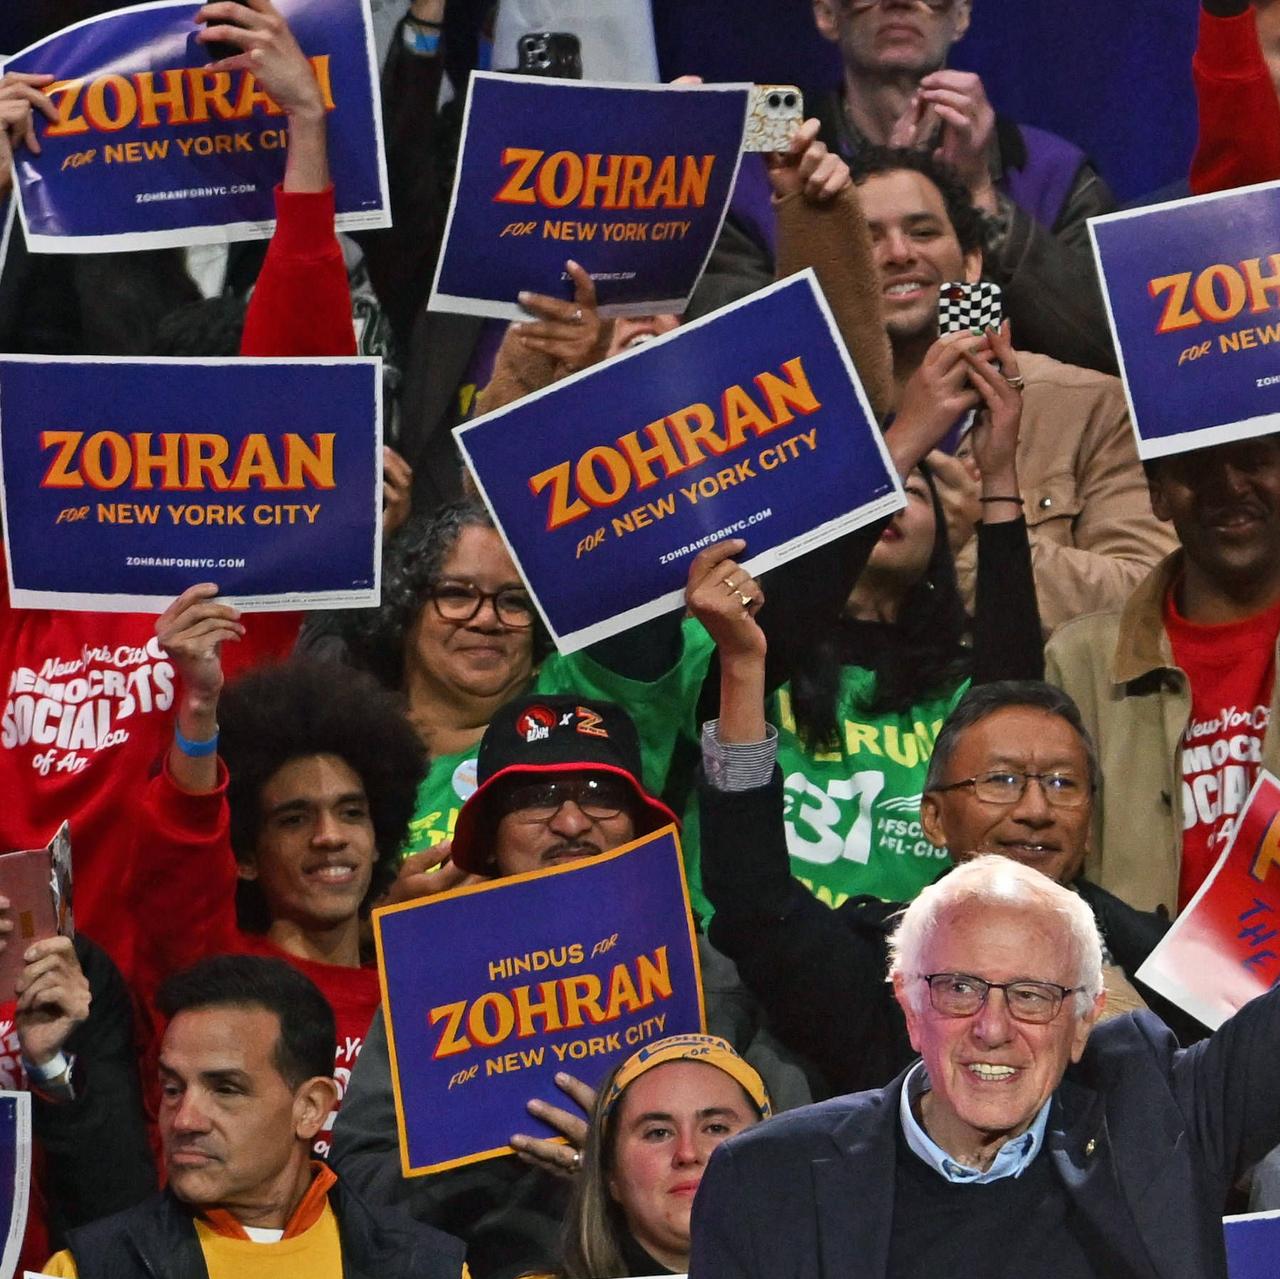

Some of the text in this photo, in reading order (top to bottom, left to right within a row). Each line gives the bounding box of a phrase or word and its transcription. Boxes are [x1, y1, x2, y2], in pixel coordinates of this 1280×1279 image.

[61, 130, 288, 171] FOR NEW YORK CI
[136, 185, 256, 203] ZOHRANFORNYC.COM
[493, 147, 716, 210] ZOHRAN
[500, 220, 691, 242] FOR NEW YORK CITY
[1177, 340, 1212, 366] FOR
[39, 430, 338, 491] ZOHRAN
[528, 356, 822, 531] ZOHRAN
[56, 504, 321, 525] FOR NEW YORK CITY
[576, 428, 819, 560] FOR NEW YORK CITY
[659, 508, 772, 565] ZOHRANFORNYC.COM
[126, 556, 246, 570] ZOHRANFORNYC.COM
[39, 657, 83, 680] New
[1219, 705, 1253, 733] Yor
[1252, 704, 1272, 731] Ci
[32, 749, 57, 776] of
[784, 770, 885, 865] 37
[878, 817, 923, 839] AFSC
[488, 933, 619, 981] HINDUS FOR
[427, 945, 673, 1059] ZOHRAN
[448, 1065, 479, 1089] FOR
[486, 1047, 545, 1077] NEW
[551, 1031, 621, 1062] YORK
[625, 1014, 666, 1044] CITY
